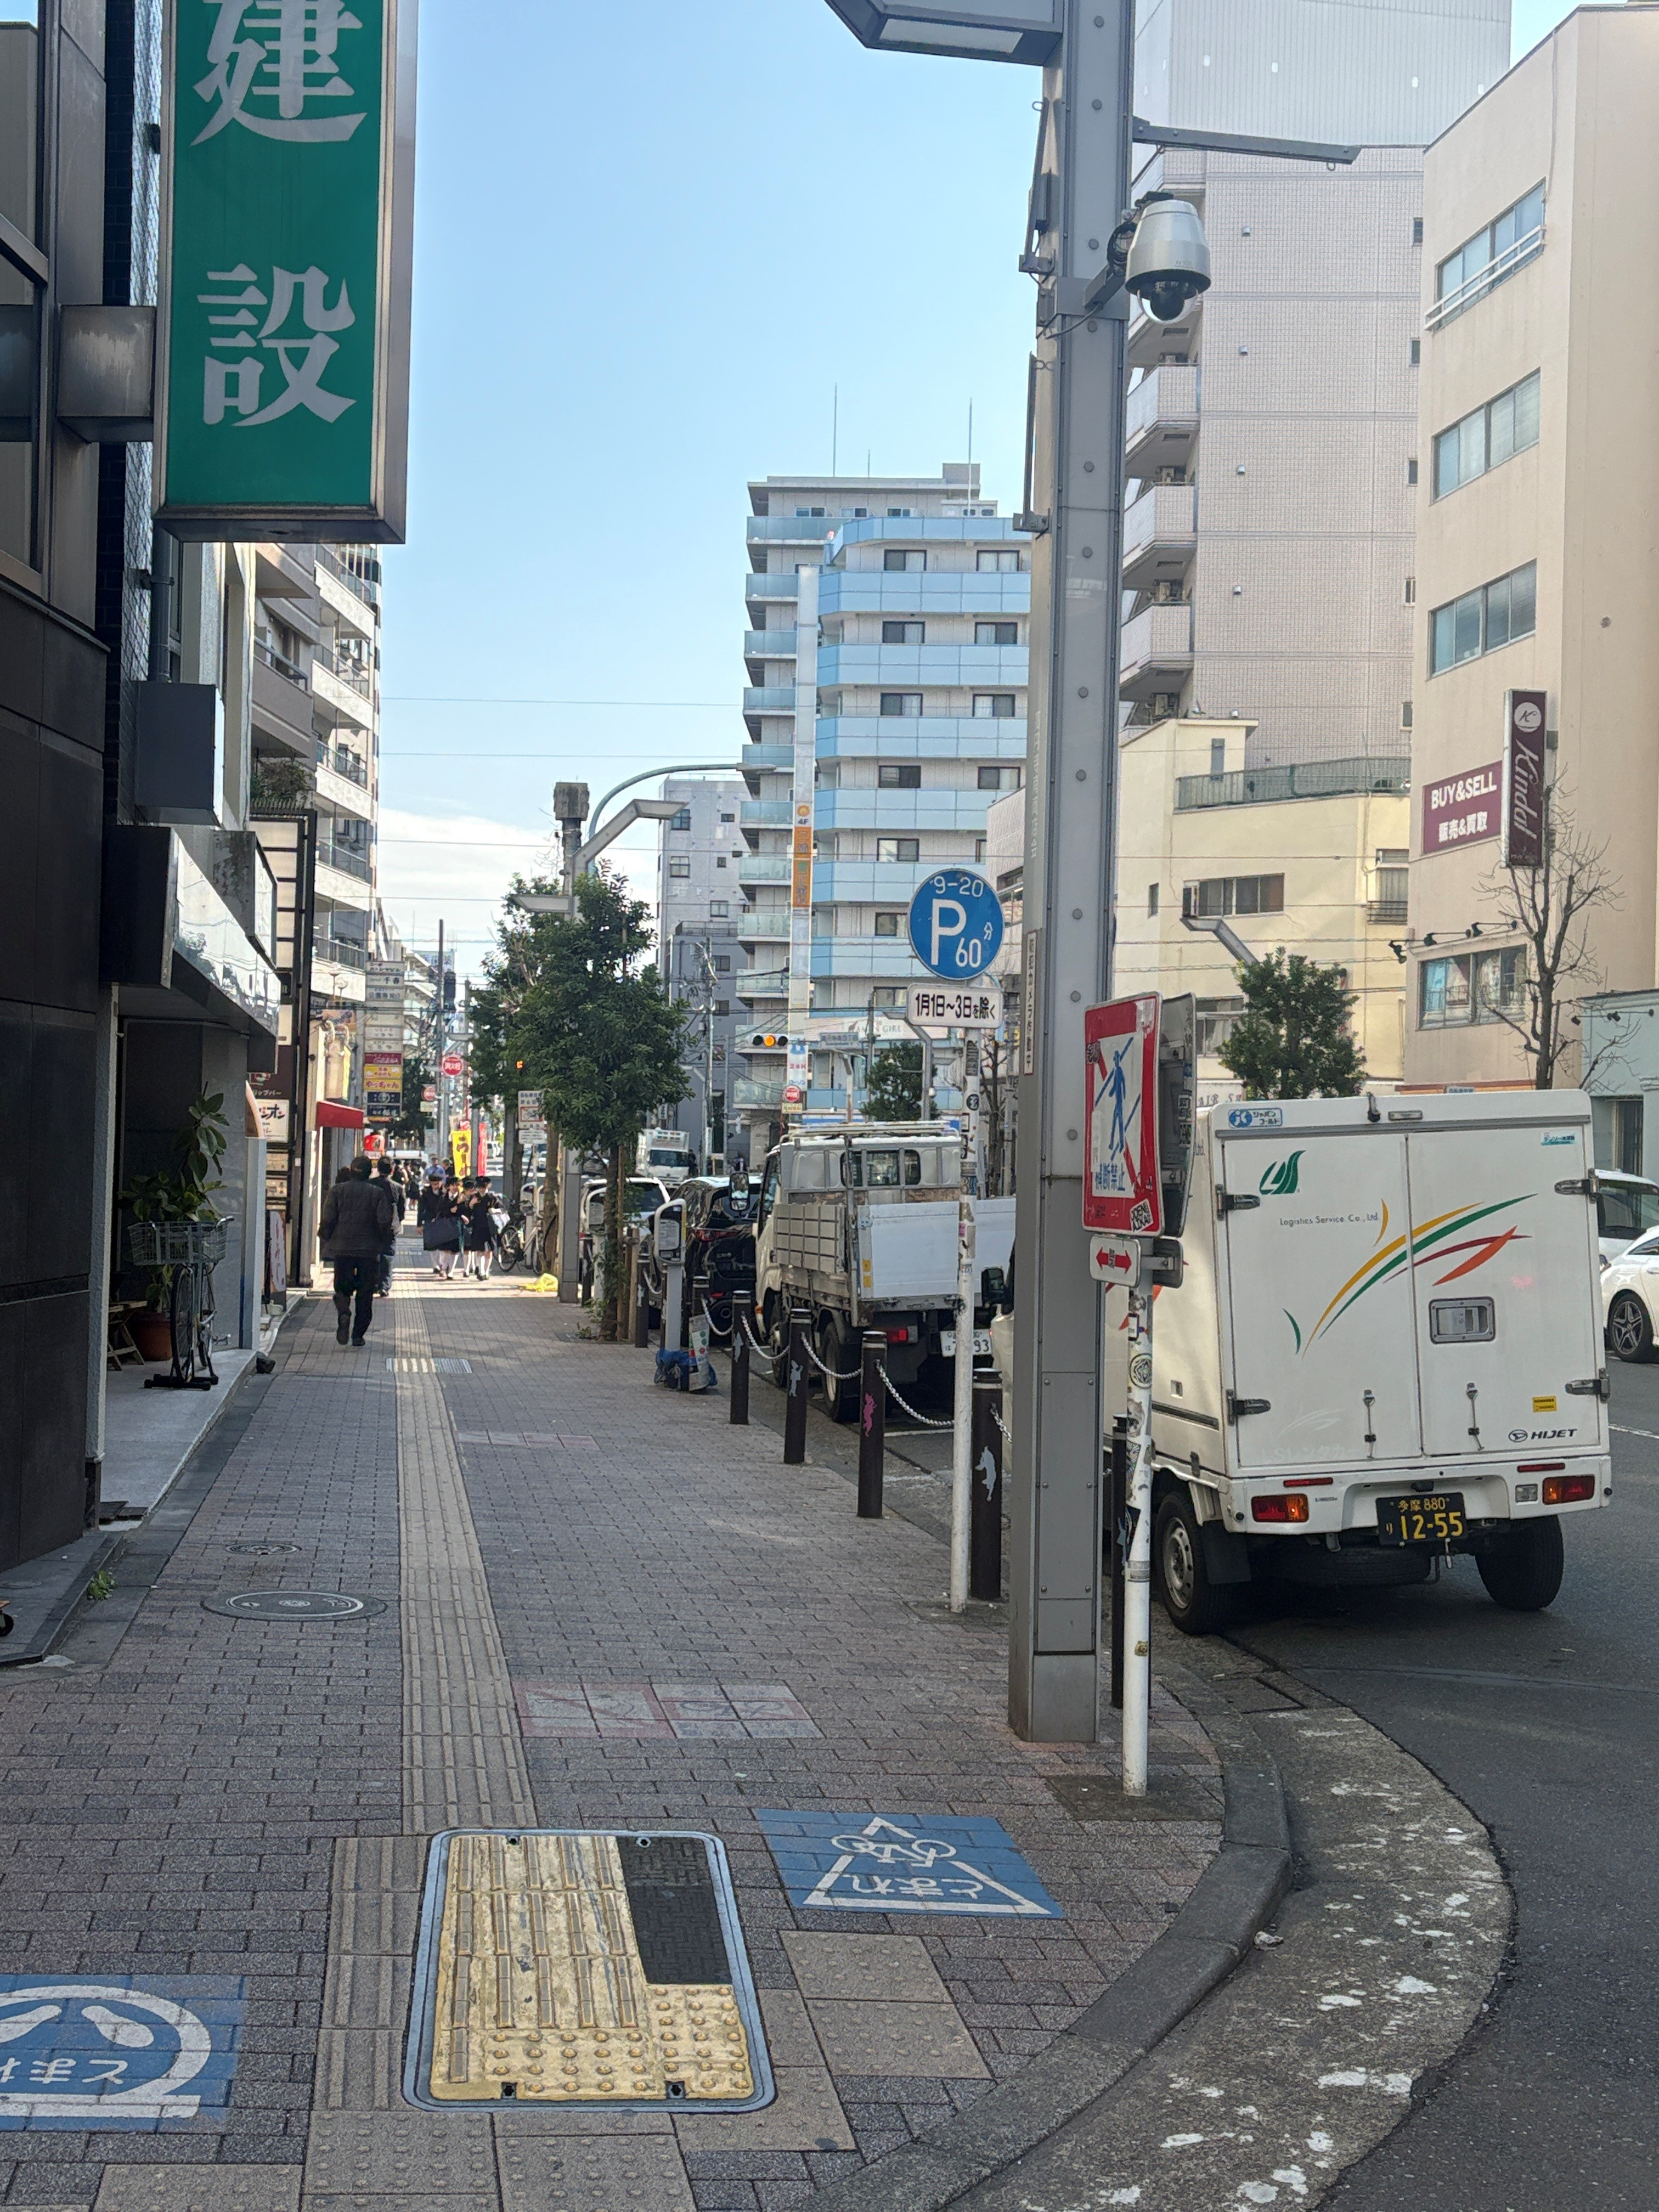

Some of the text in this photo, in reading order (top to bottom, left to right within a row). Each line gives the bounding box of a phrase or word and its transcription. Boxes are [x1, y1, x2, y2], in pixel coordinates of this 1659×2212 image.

[189, 0, 369, 428] 建設
[1431, 771, 1498, 810] BUY&SELL
[1513, 738, 1539, 840] Kindal
[933, 876, 984, 898] 9-20
[930, 898, 967, 966] P
[1095, 1162, 1126, 1192] 横断禁止
[1279, 1217, 1313, 1228] Logistics
[1315, 1215, 1345, 1224] Service
[1531, 1428, 1578, 1440] HIJET
[1397, 1497, 1446, 1513] 多摩 880
[1400, 1511, 1463, 1541] 12-55
